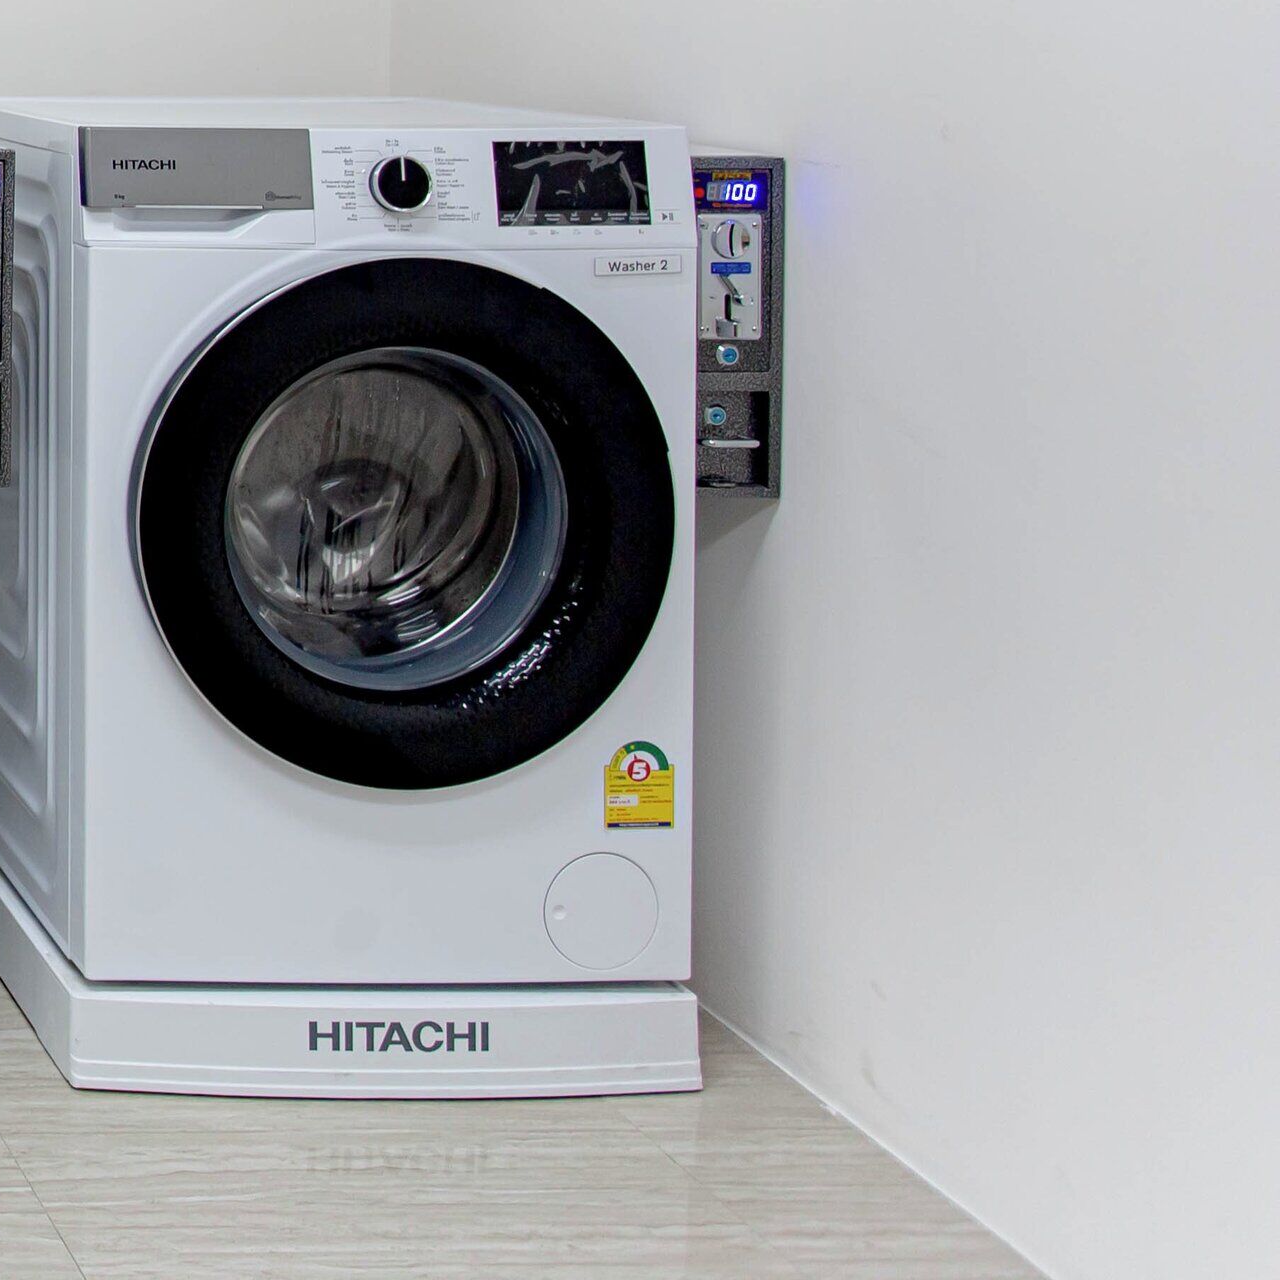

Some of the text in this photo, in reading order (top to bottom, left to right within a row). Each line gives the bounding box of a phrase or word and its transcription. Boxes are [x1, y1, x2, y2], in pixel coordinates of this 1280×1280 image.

[112, 159, 176, 170] HITACHI
[725, 183, 757, 201] 100
[608, 260, 668, 272] Washer 2
[631, 761, 647, 781] 5
[308, 1020, 490, 1052] HITACHI
